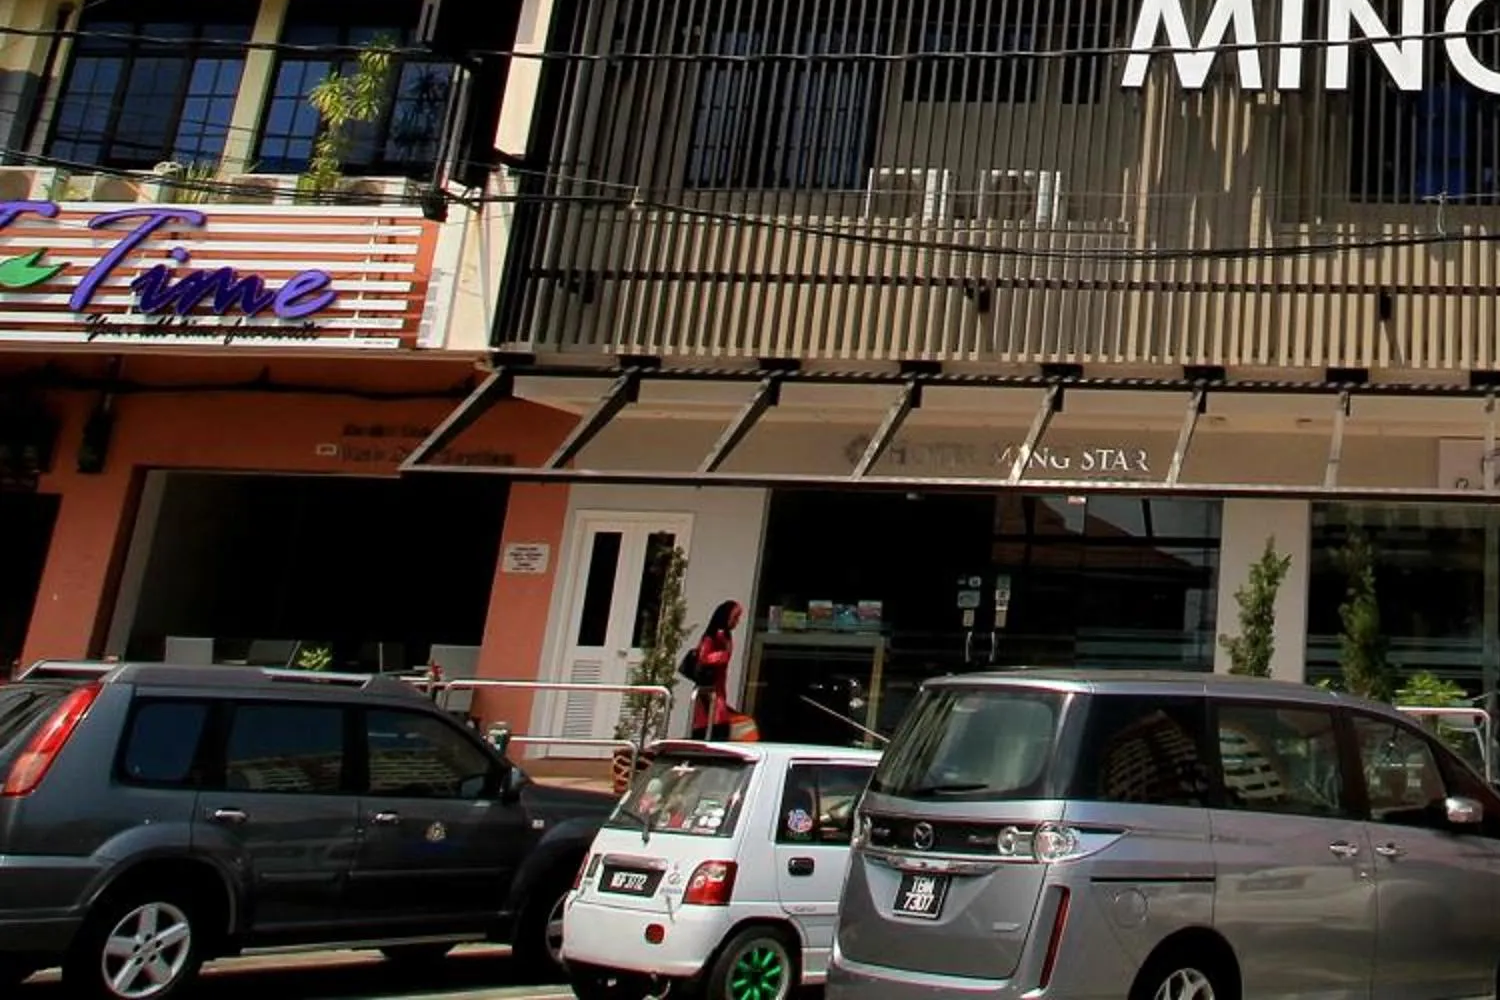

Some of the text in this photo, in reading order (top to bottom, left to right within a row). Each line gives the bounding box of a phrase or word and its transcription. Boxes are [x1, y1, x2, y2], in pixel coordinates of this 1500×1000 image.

[69, 206, 337, 320] Time
[1080, 448, 1151, 472] STAR
[903, 892, 935, 912] 7307
